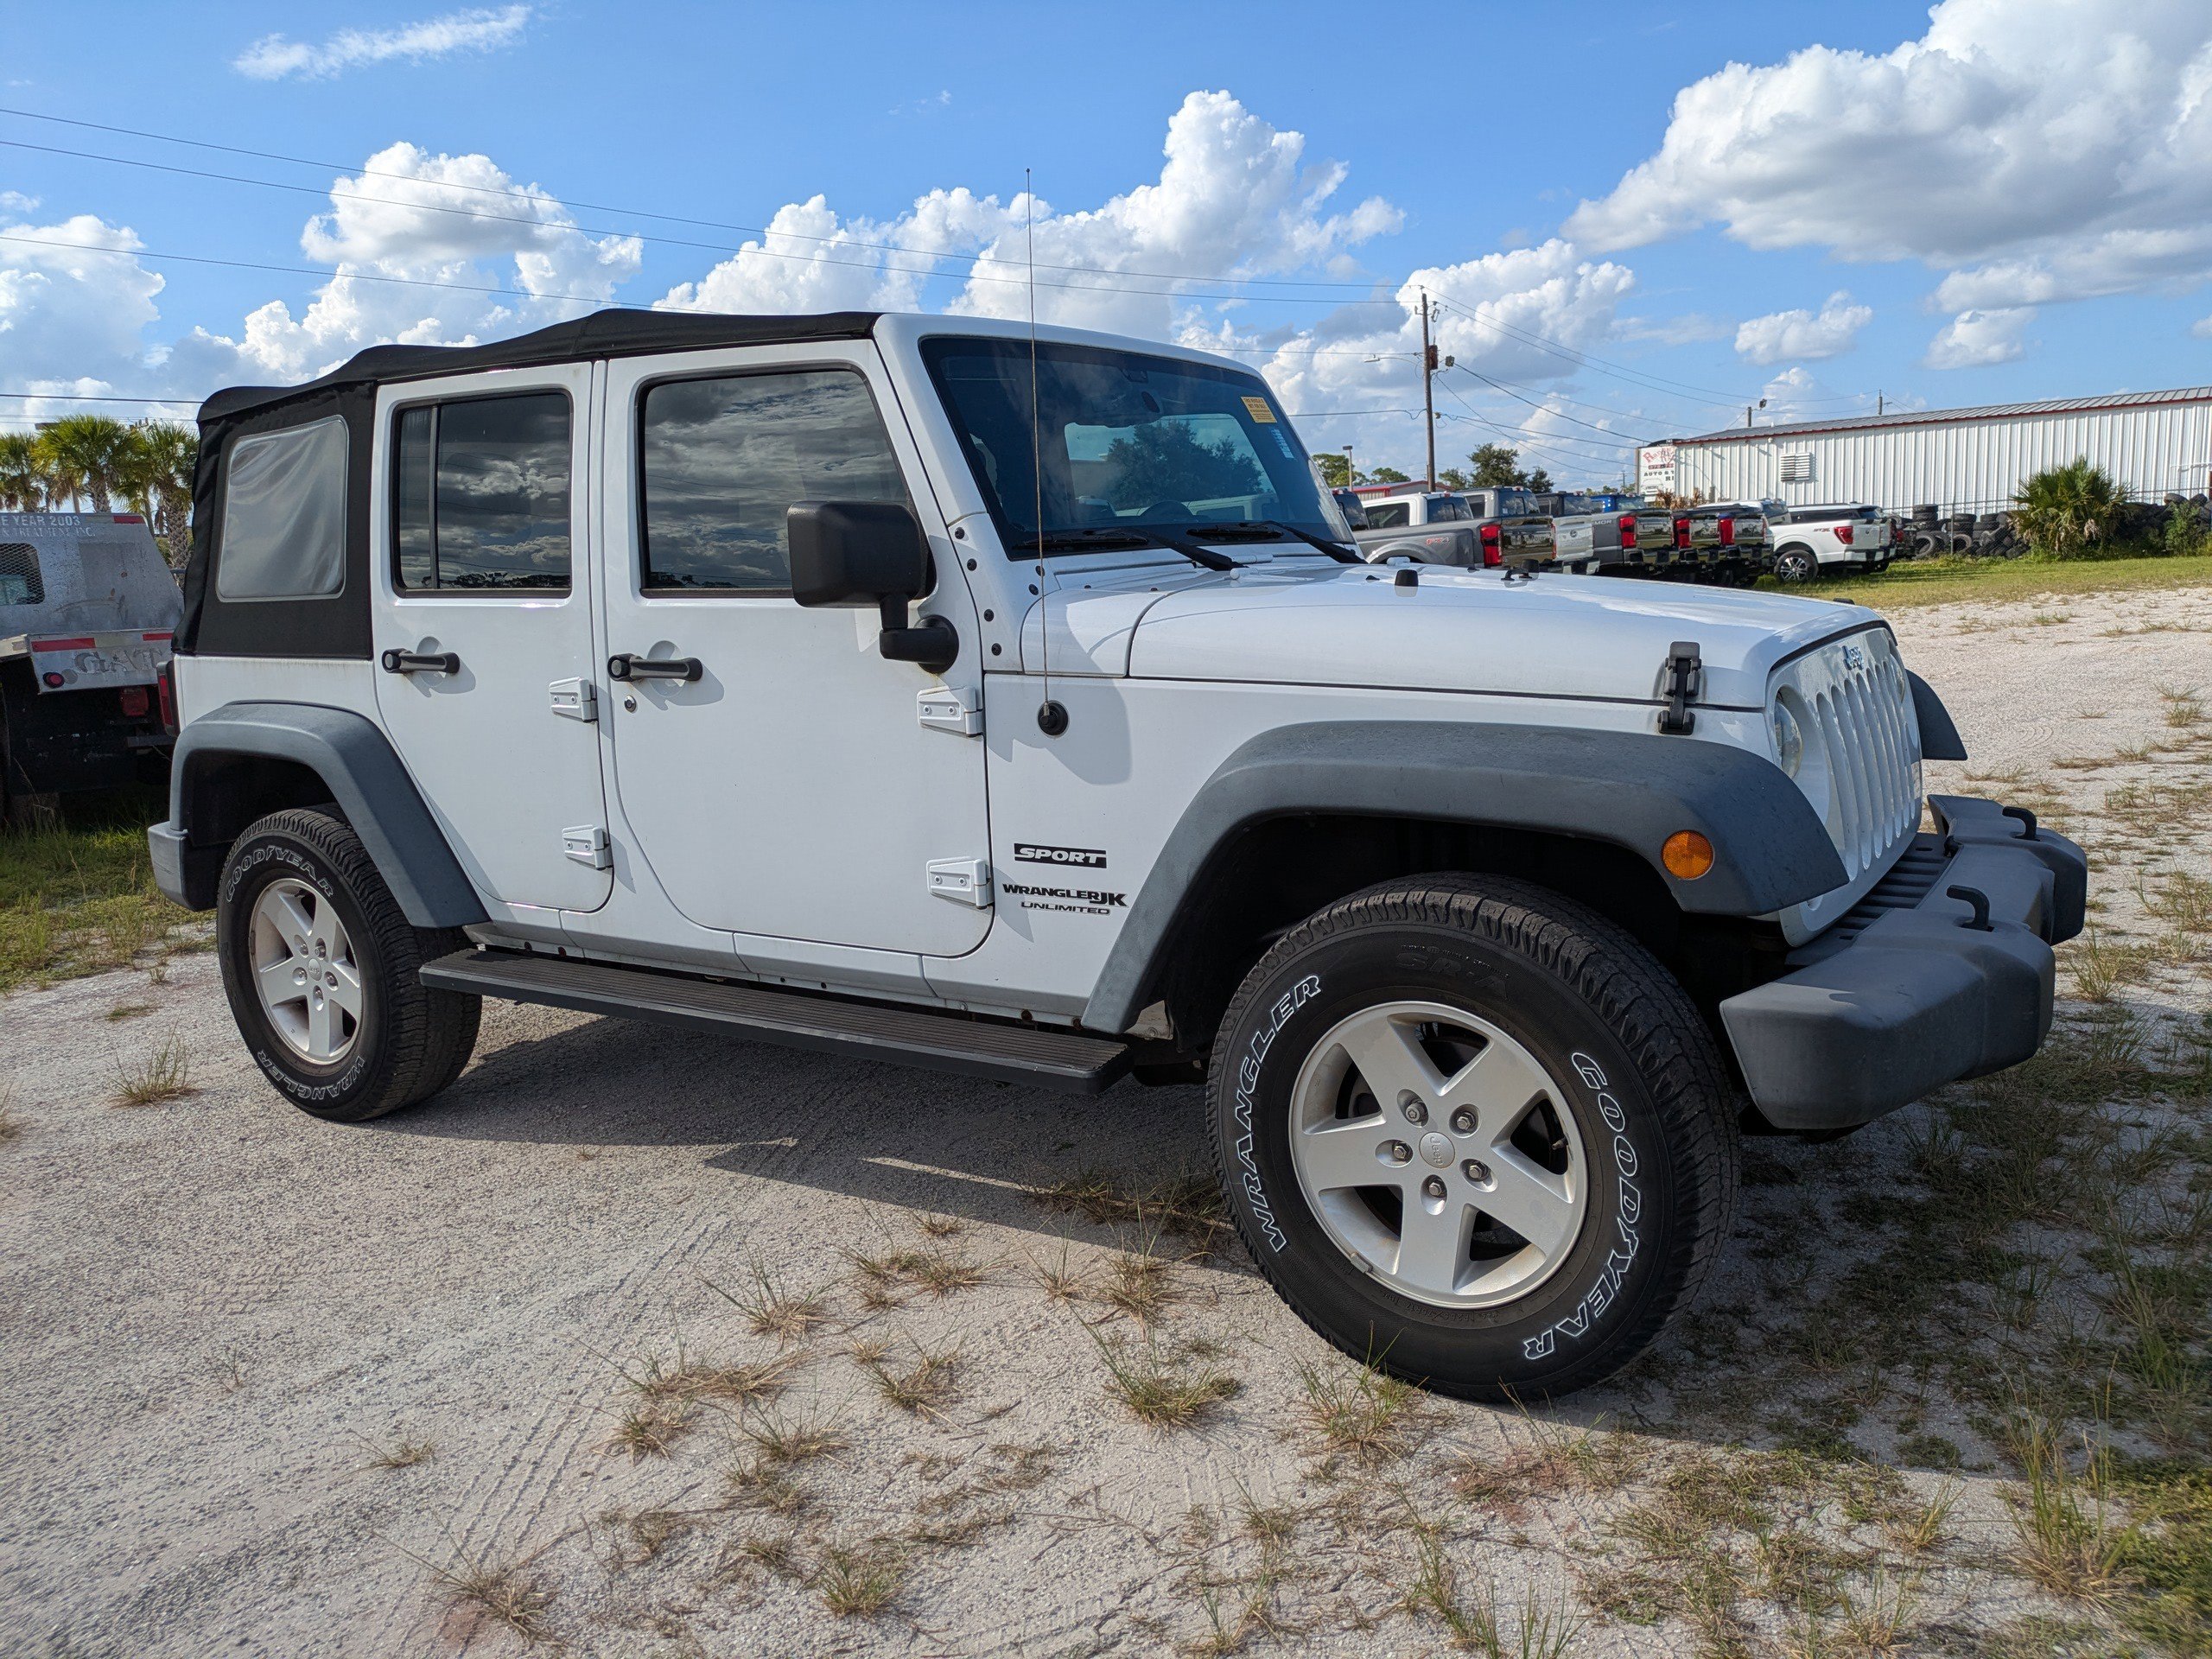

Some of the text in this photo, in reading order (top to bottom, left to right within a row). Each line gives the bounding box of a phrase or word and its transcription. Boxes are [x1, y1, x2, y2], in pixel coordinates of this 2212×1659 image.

[12, 515, 45, 526] YEAR
[49, 515, 81, 526] 2003
[226, 845, 334, 902] GOODYEAR
[1017, 848, 1106, 864] SPORT
[1020, 901, 1110, 916] UNLIMITED
[257, 1050, 365, 1101] WRANGLER
[1234, 974, 1323, 1253] WRANGLER
[1430, 1136, 1444, 1166] Jeep
[1523, 1052, 1641, 1361] GOODYEAR
